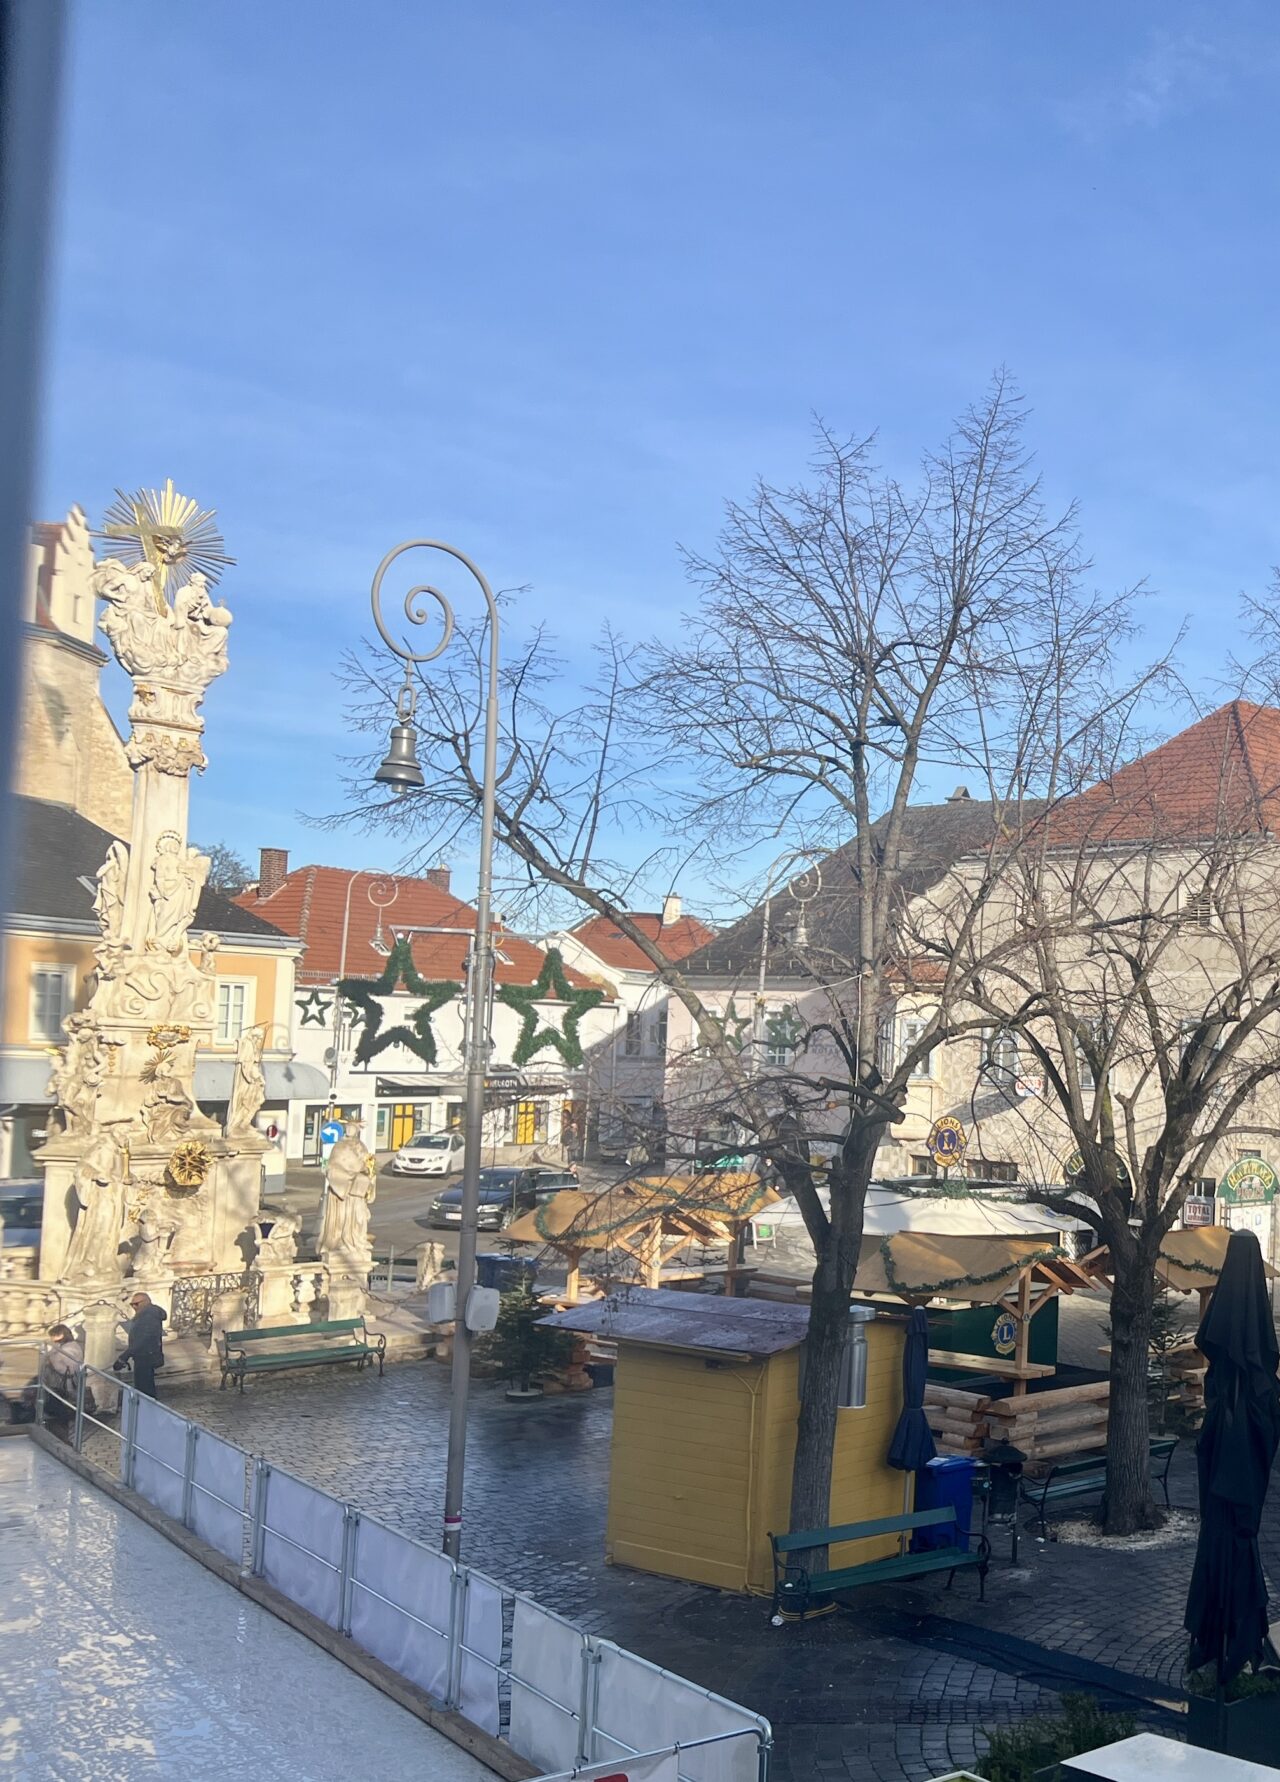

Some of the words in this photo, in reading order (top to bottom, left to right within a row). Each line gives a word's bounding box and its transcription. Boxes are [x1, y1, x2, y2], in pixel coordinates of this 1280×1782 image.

[936, 1118, 959, 1129] LIONS
[943, 1131, 953, 1150] L
[1187, 1205, 1211, 1216] TOTAL
[1003, 1325, 1011, 1340] L
